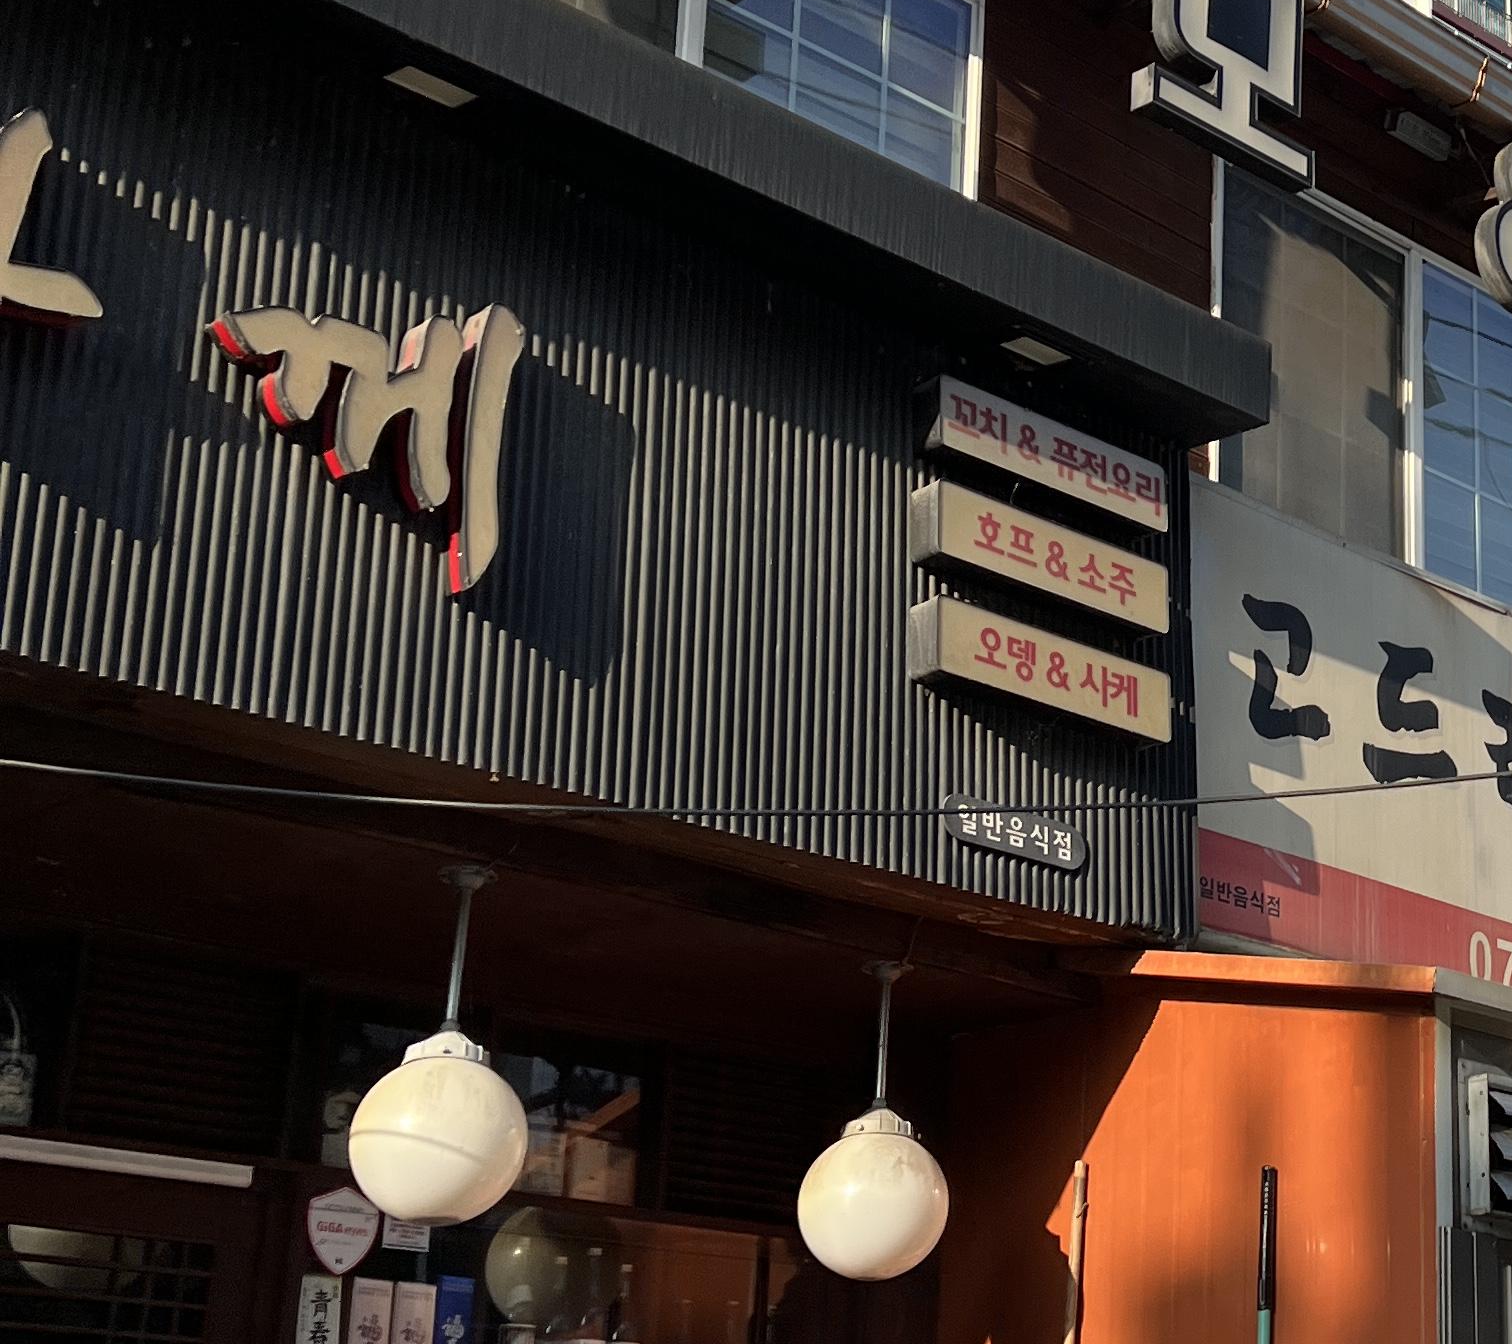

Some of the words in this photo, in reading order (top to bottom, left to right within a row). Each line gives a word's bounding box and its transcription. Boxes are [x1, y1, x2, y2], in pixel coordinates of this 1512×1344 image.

[1077, 552, 1137, 607] 소주
[1080, 662, 1140, 719] 사케
[957, 803, 1074, 862] 일반음식점
[1199, 874, 1282, 918] 일반음식점
